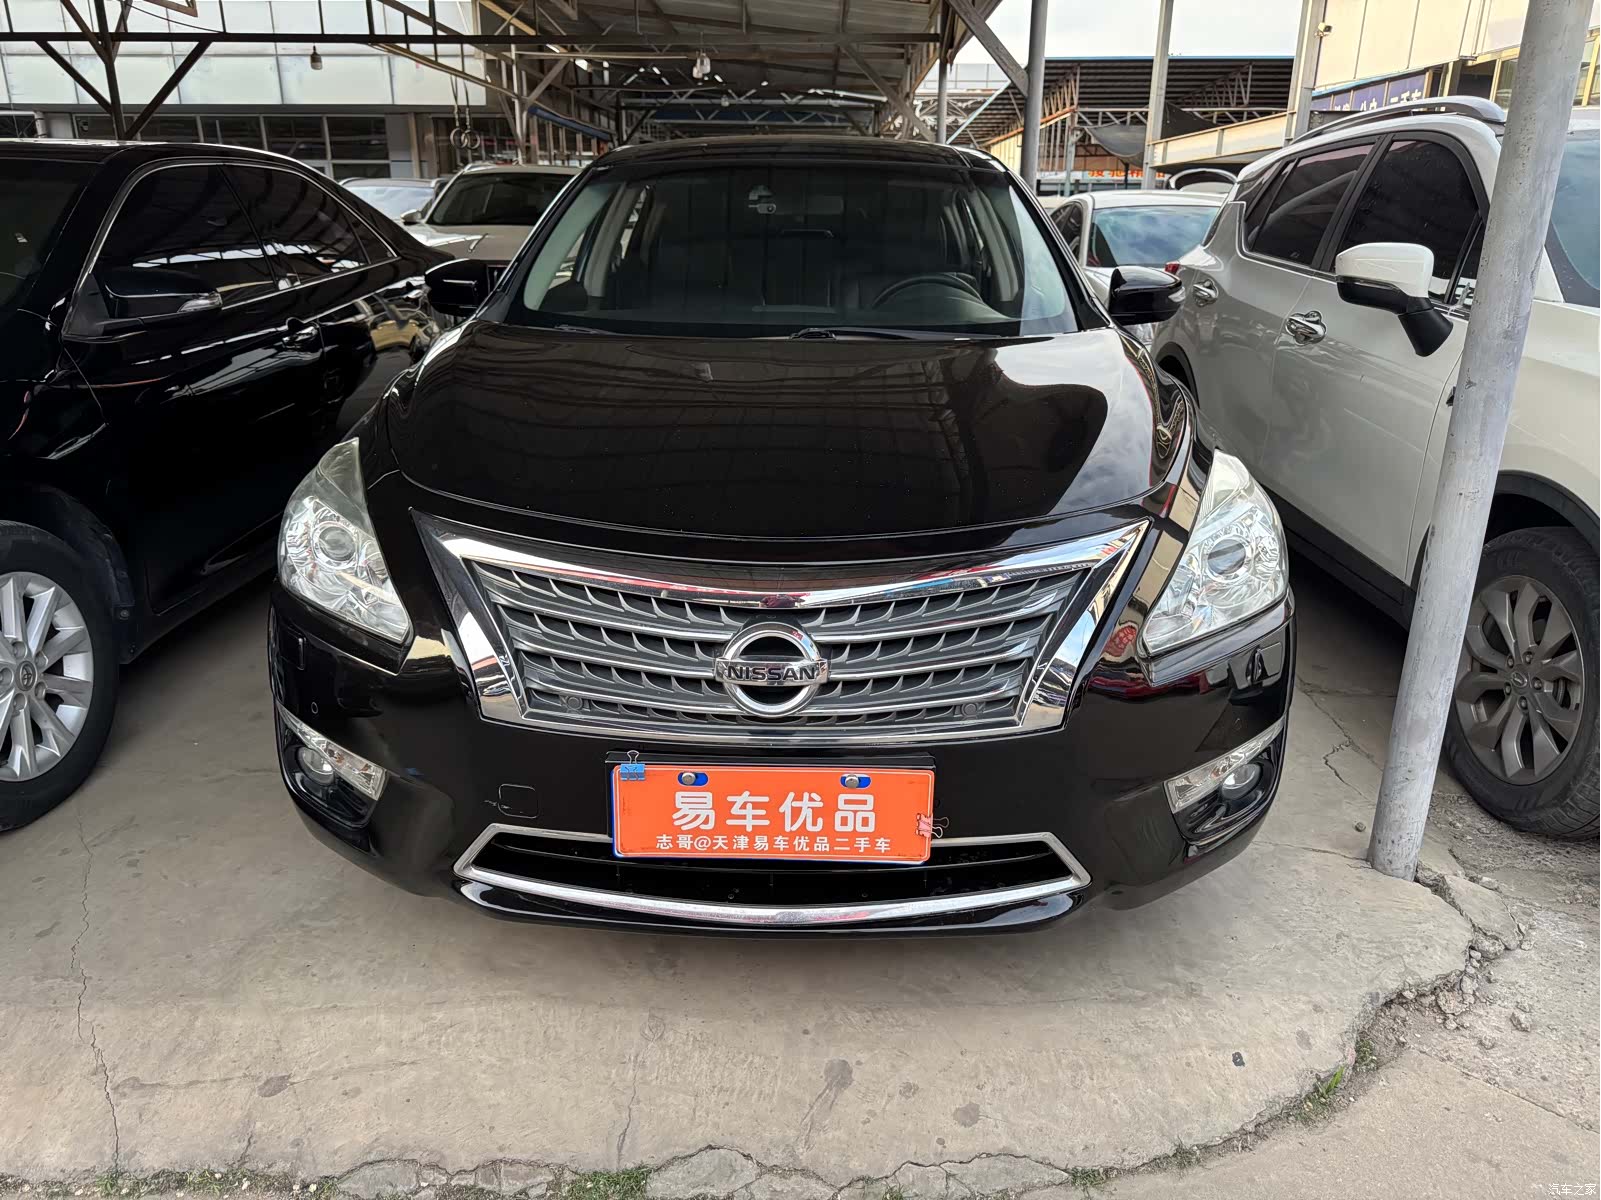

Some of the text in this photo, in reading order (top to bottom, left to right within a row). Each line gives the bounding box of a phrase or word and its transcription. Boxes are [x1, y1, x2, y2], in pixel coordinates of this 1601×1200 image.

[727, 665, 815, 681] NISSAN
[672, 790, 876, 833] 易车优品
[656, 834, 891, 853] 志哥@天津易车优品二手车
